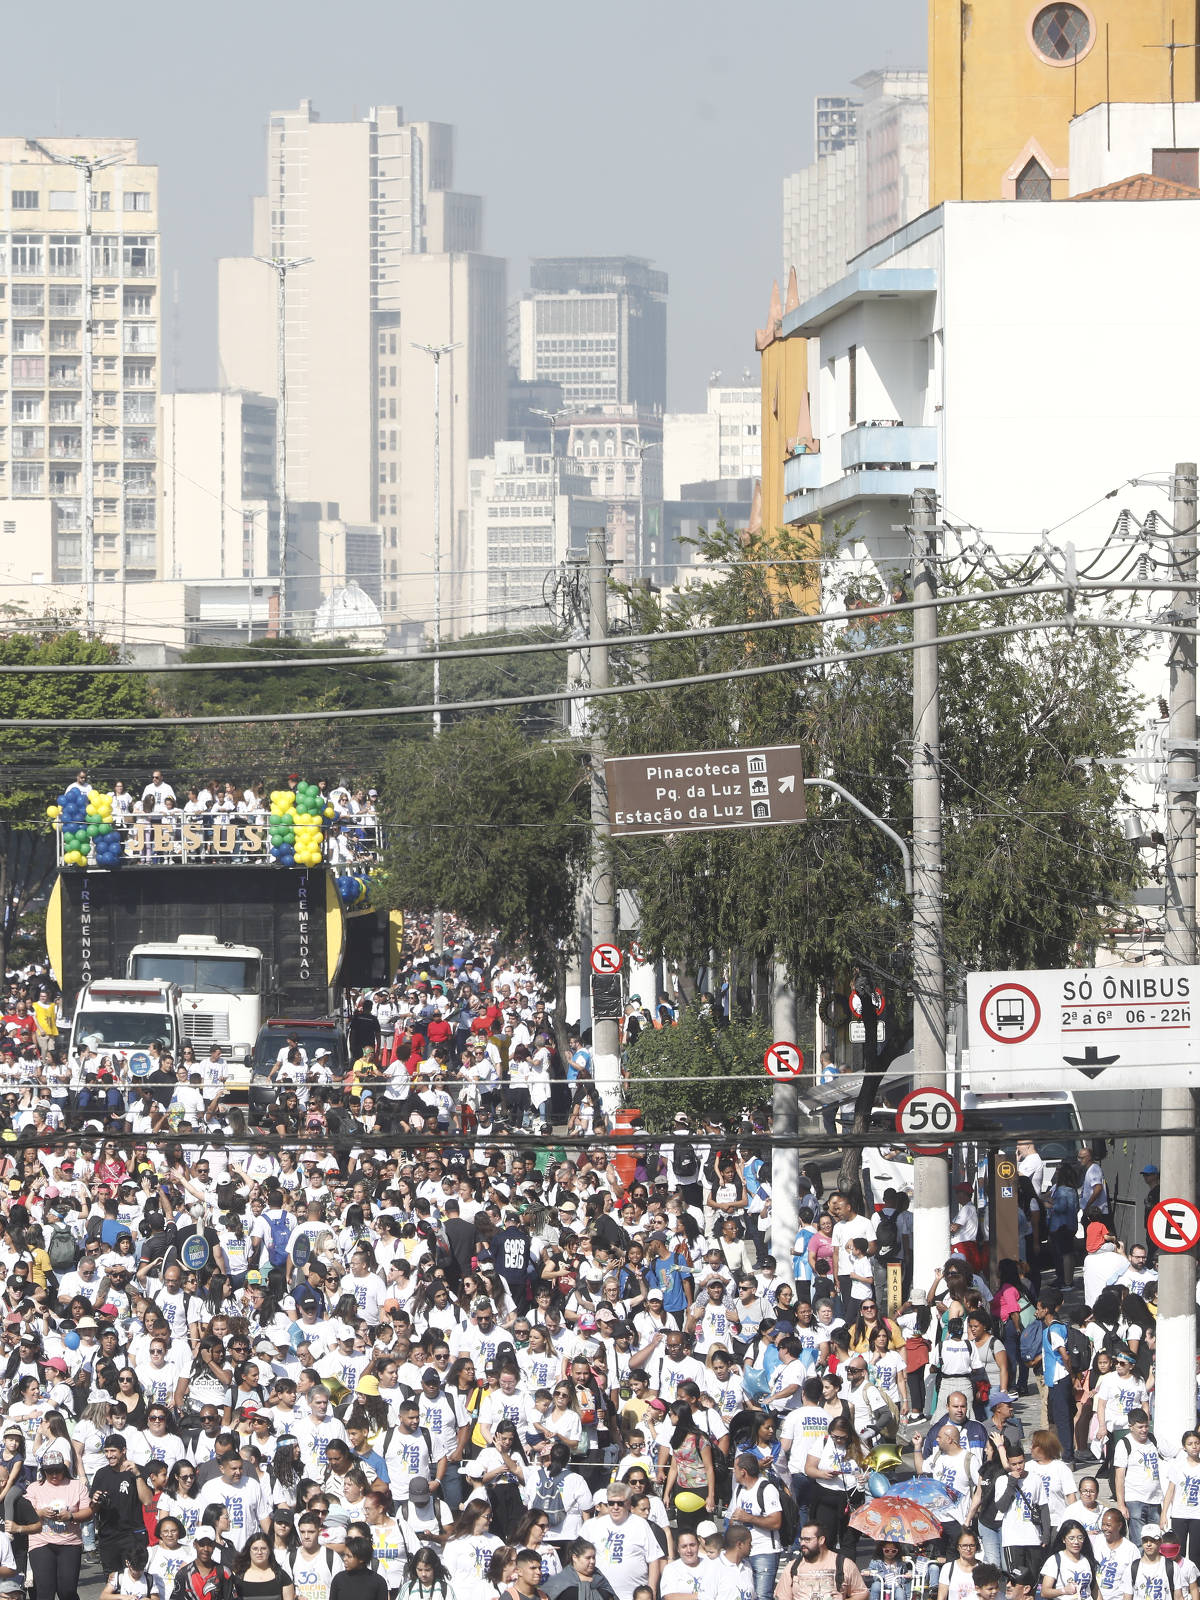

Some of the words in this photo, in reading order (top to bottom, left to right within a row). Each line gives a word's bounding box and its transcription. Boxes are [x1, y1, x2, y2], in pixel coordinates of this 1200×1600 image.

[646, 763, 740, 780] Pinacoteca
[656, 788, 681, 801] Pq.
[687, 785, 706, 798] da
[712, 783, 742, 796] Luz
[615, 806, 683, 825] Estação
[688, 806, 708, 820] da
[713, 804, 744, 818] Luz
[129, 823, 264, 852] JESUS
[81, 878, 92, 982] TREMENDAO
[298, 876, 310, 980] TREMENDAO
[1063, 973, 1093, 1001] SÓ
[1103, 975, 1190, 1000] ÔNIBUS
[1062, 1011, 1078, 1025] 2ª
[1097, 1009, 1113, 1024] 6ª
[1126, 1010, 1146, 1023] 06
[1160, 1008, 1191, 1023] 22h
[909, 1102, 952, 1131] 50
[1165, 1210, 1186, 1241] E
[359, 1286, 367, 1311] JESUS
[716, 1313, 725, 1336] JESUS
[537, 1363, 548, 1387] JESUS
[882, 1366, 892, 1390] JESUS
[725, 1390, 736, 1412] JESUS
[431, 1409, 442, 1435] JESUS
[802, 1416, 828, 1426] JESUS
[318, 1438, 329, 1466] JESUS
[408, 1445, 420, 1474] JESUS
[1188, 1479, 1200, 1507] JESUS
[232, 1496, 242, 1529] JESUS
[615, 1533, 625, 1564] JESUS
[1106, 1561, 1118, 1589] JESUS
